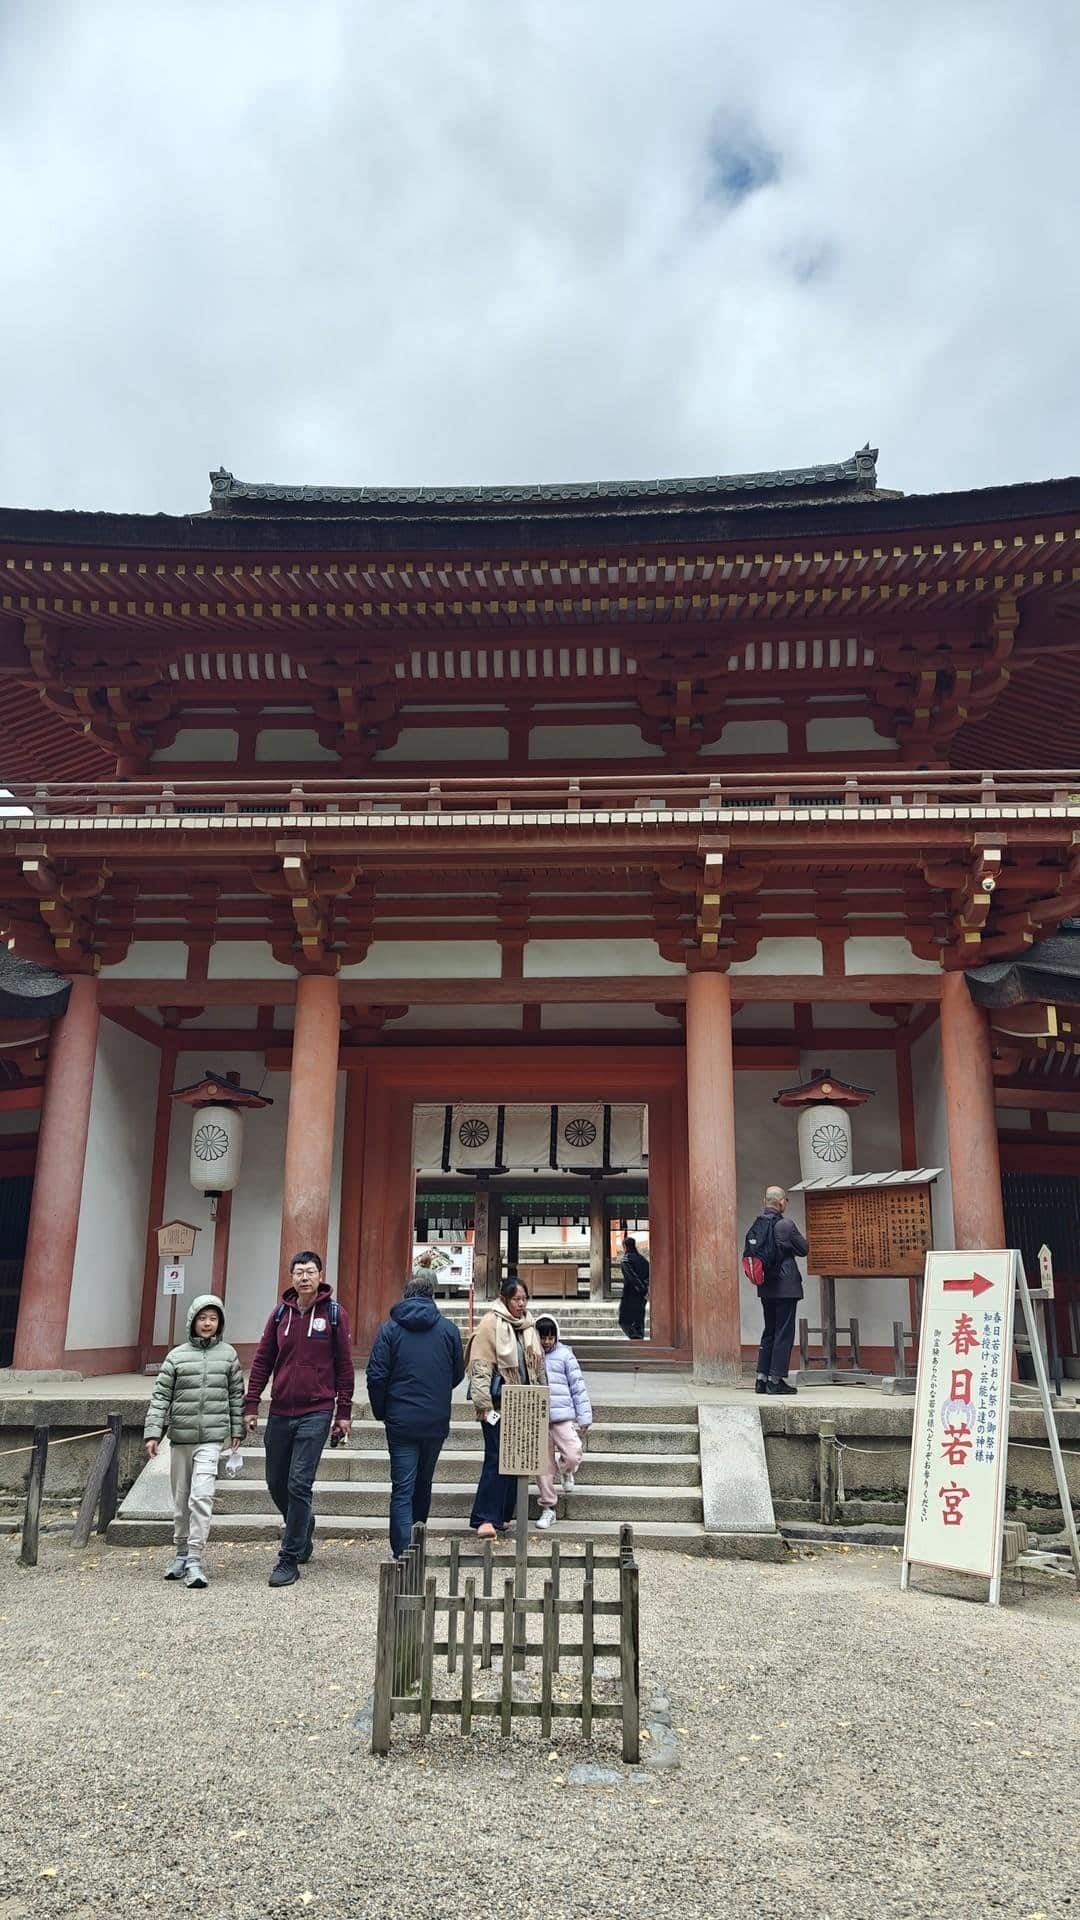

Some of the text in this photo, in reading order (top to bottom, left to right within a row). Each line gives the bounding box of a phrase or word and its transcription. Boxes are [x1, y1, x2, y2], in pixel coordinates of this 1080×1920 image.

[938, 1313, 980, 1526] 春日若宮
[975, 1312, 993, 1462] 知恵授け・芸能上達の神様
[985, 1311, 1002, 1464] 春日若宮おん祭の御祭神
